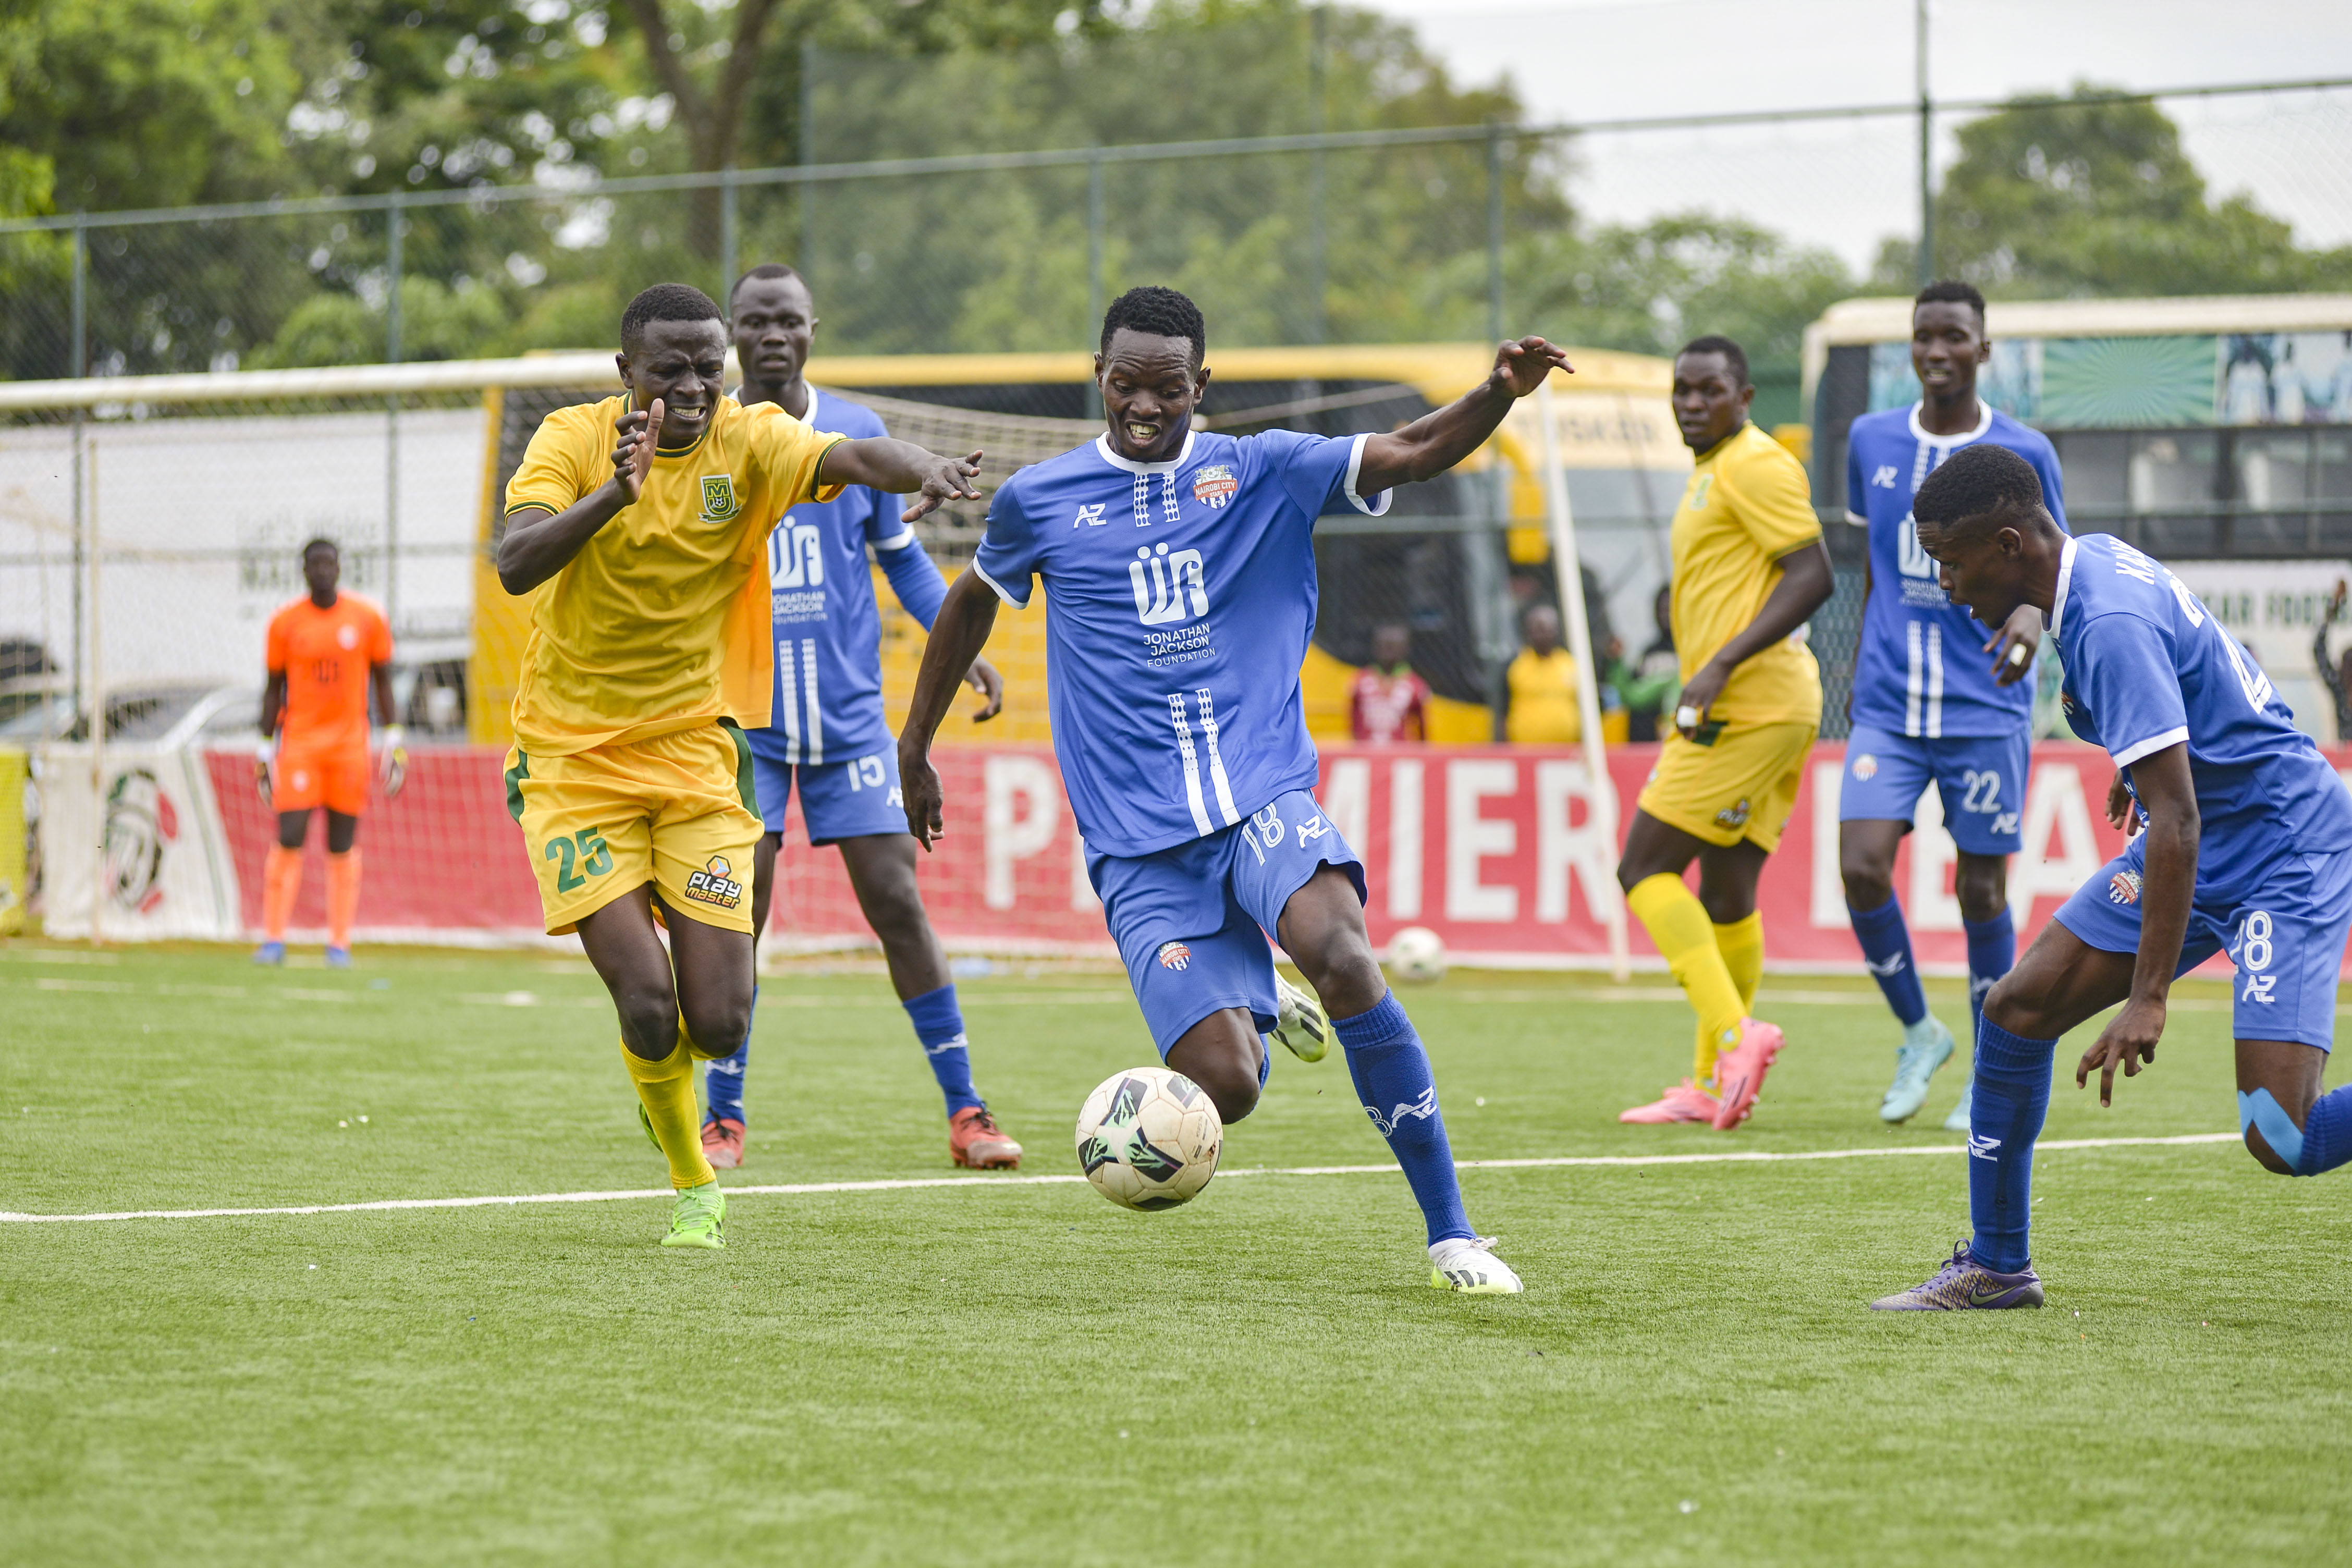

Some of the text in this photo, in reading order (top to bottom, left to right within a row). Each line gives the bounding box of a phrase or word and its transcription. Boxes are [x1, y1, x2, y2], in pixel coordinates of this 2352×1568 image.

[1195, 482, 1220, 497] NAIROBI
[1073, 503, 1107, 528] AZ
[773, 591, 826, 606] ONATHAN
[774, 612, 828, 625] OUNDATION
[1143, 622, 1210, 646] JONATHAN
[1150, 635, 1209, 657] JACKSON
[1147, 647, 1216, 668] FOUNDATION
[847, 755, 886, 792] 15
[1962, 769, 2001, 813] 22
[983, 755, 1624, 924] PIER
[1241, 802, 1285, 867] 18
[1296, 815, 1330, 849] AZ
[545, 826, 614, 894] 25
[687, 887, 740, 908] master
[1161, 949, 1179, 965] NAIROBI
[2242, 974, 2277, 1002] AZ
